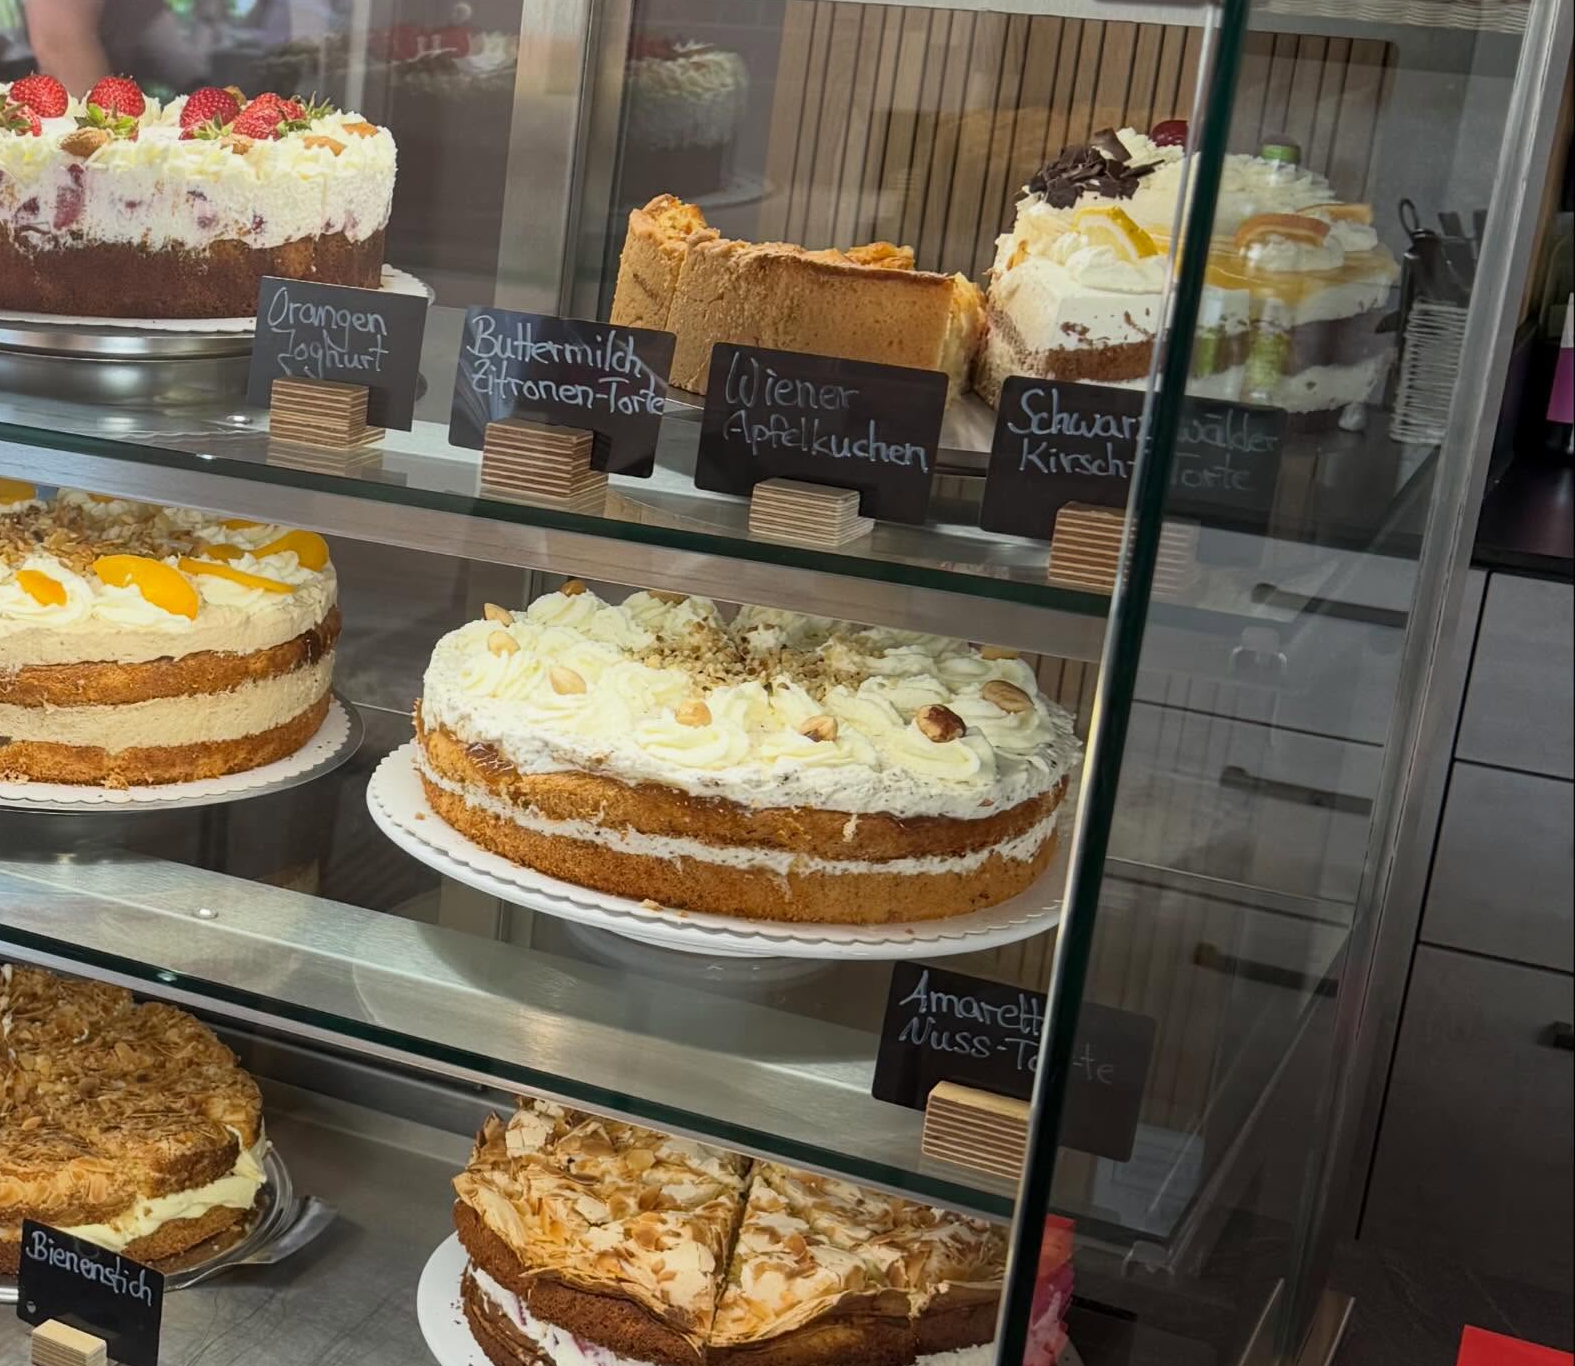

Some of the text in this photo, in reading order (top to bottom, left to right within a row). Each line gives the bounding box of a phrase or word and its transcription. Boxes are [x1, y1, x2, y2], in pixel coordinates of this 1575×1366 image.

[266, 284, 387, 343] Orangen
[467, 313, 644, 378] Buttermilch
[471, 357, 665, 417] Zitronen-Torte
[725, 349, 860, 412] Wiener
[724, 408, 929, 475] Apfelkuchen
[25, 1229, 153, 1307] Bienenstich
